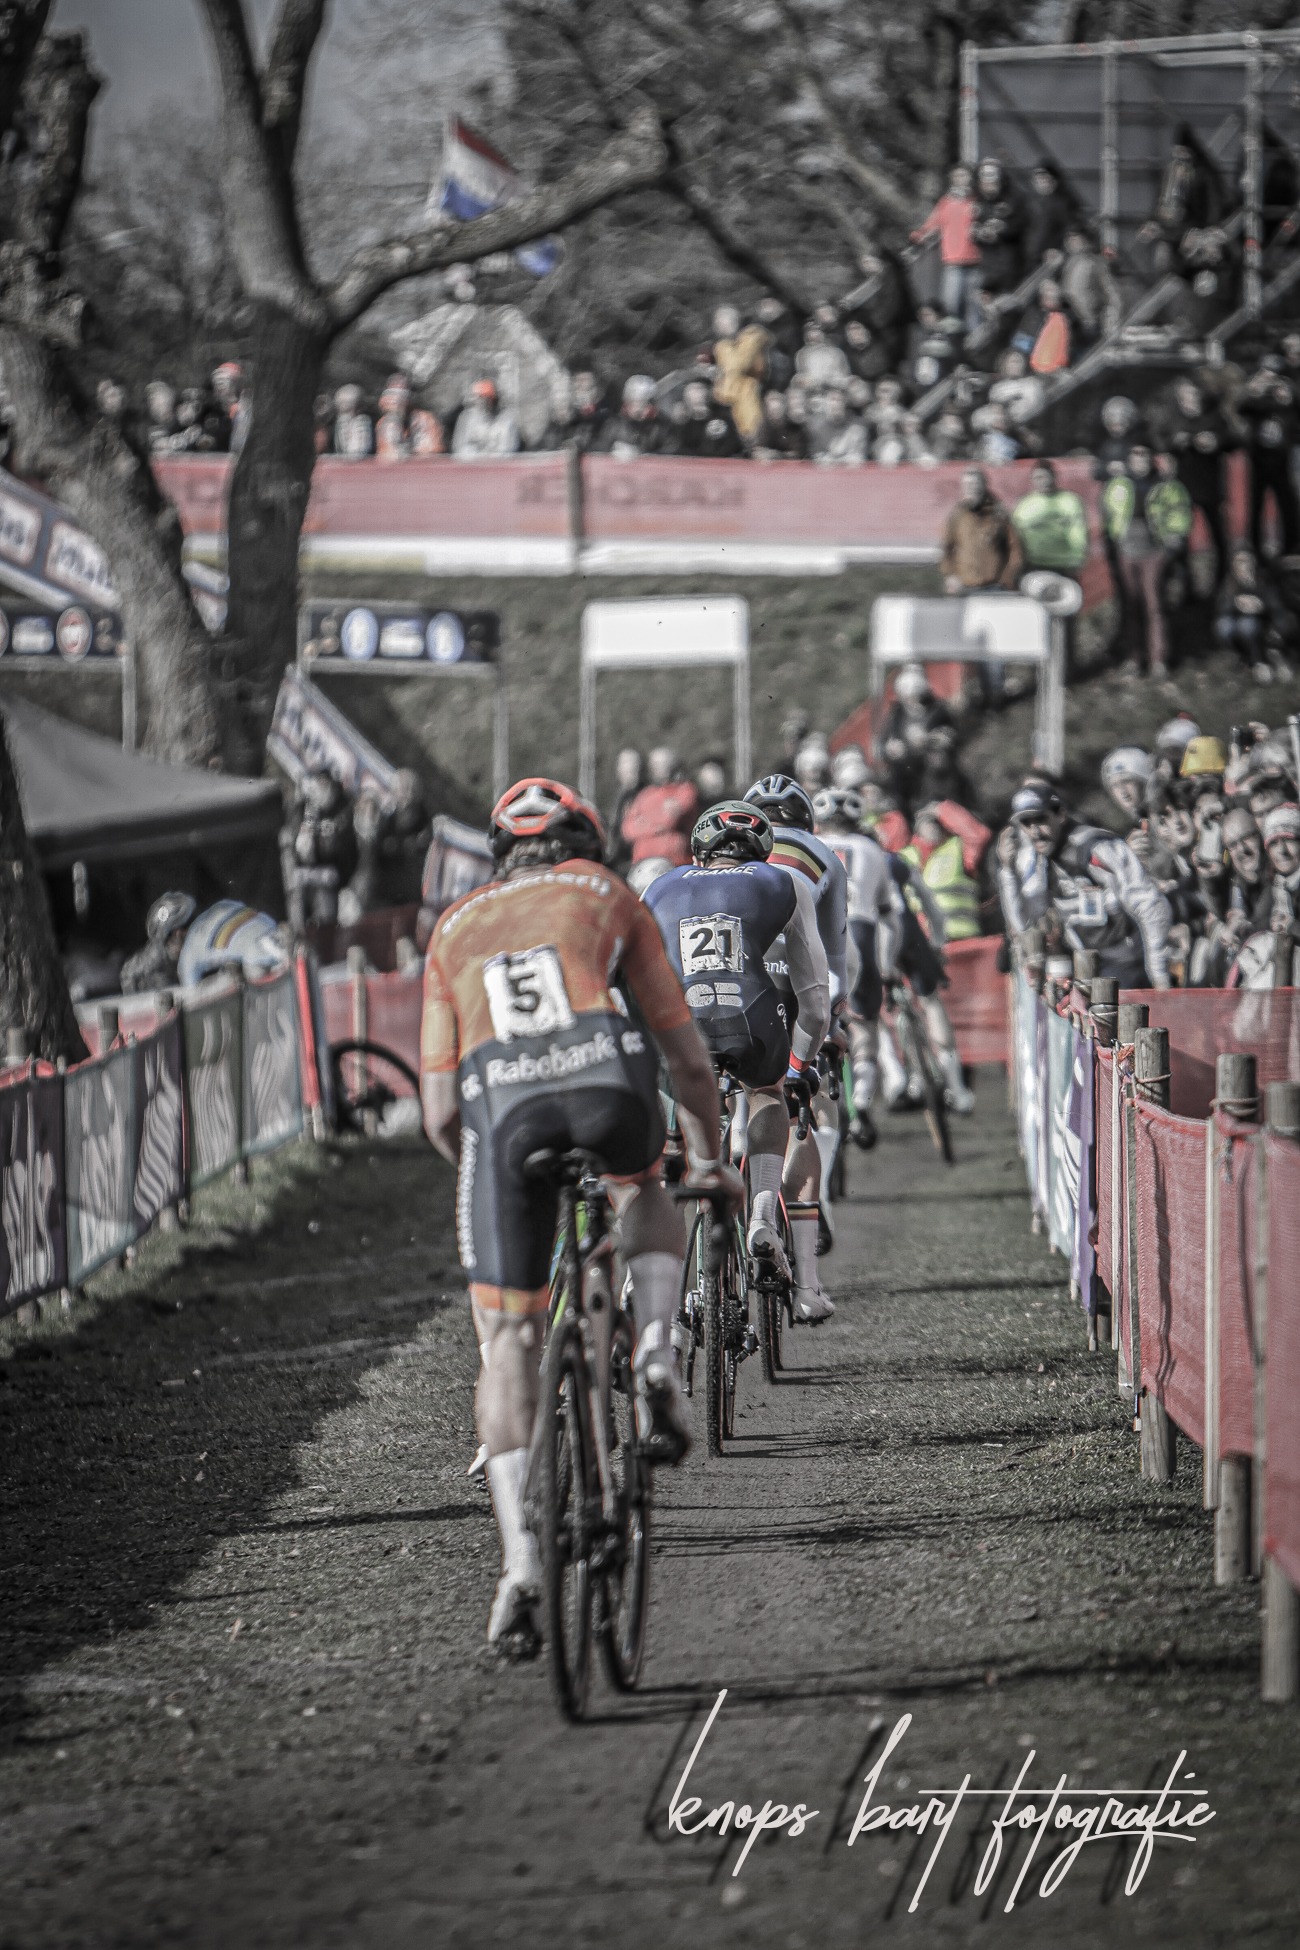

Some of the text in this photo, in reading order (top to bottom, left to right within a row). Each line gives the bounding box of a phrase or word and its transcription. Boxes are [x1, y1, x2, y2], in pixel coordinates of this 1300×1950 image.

[682, 866, 757, 879] FRANCE
[688, 927, 733, 960] 21
[505, 971, 542, 1014] 5
[486, 1031, 619, 1088] Rabobank
